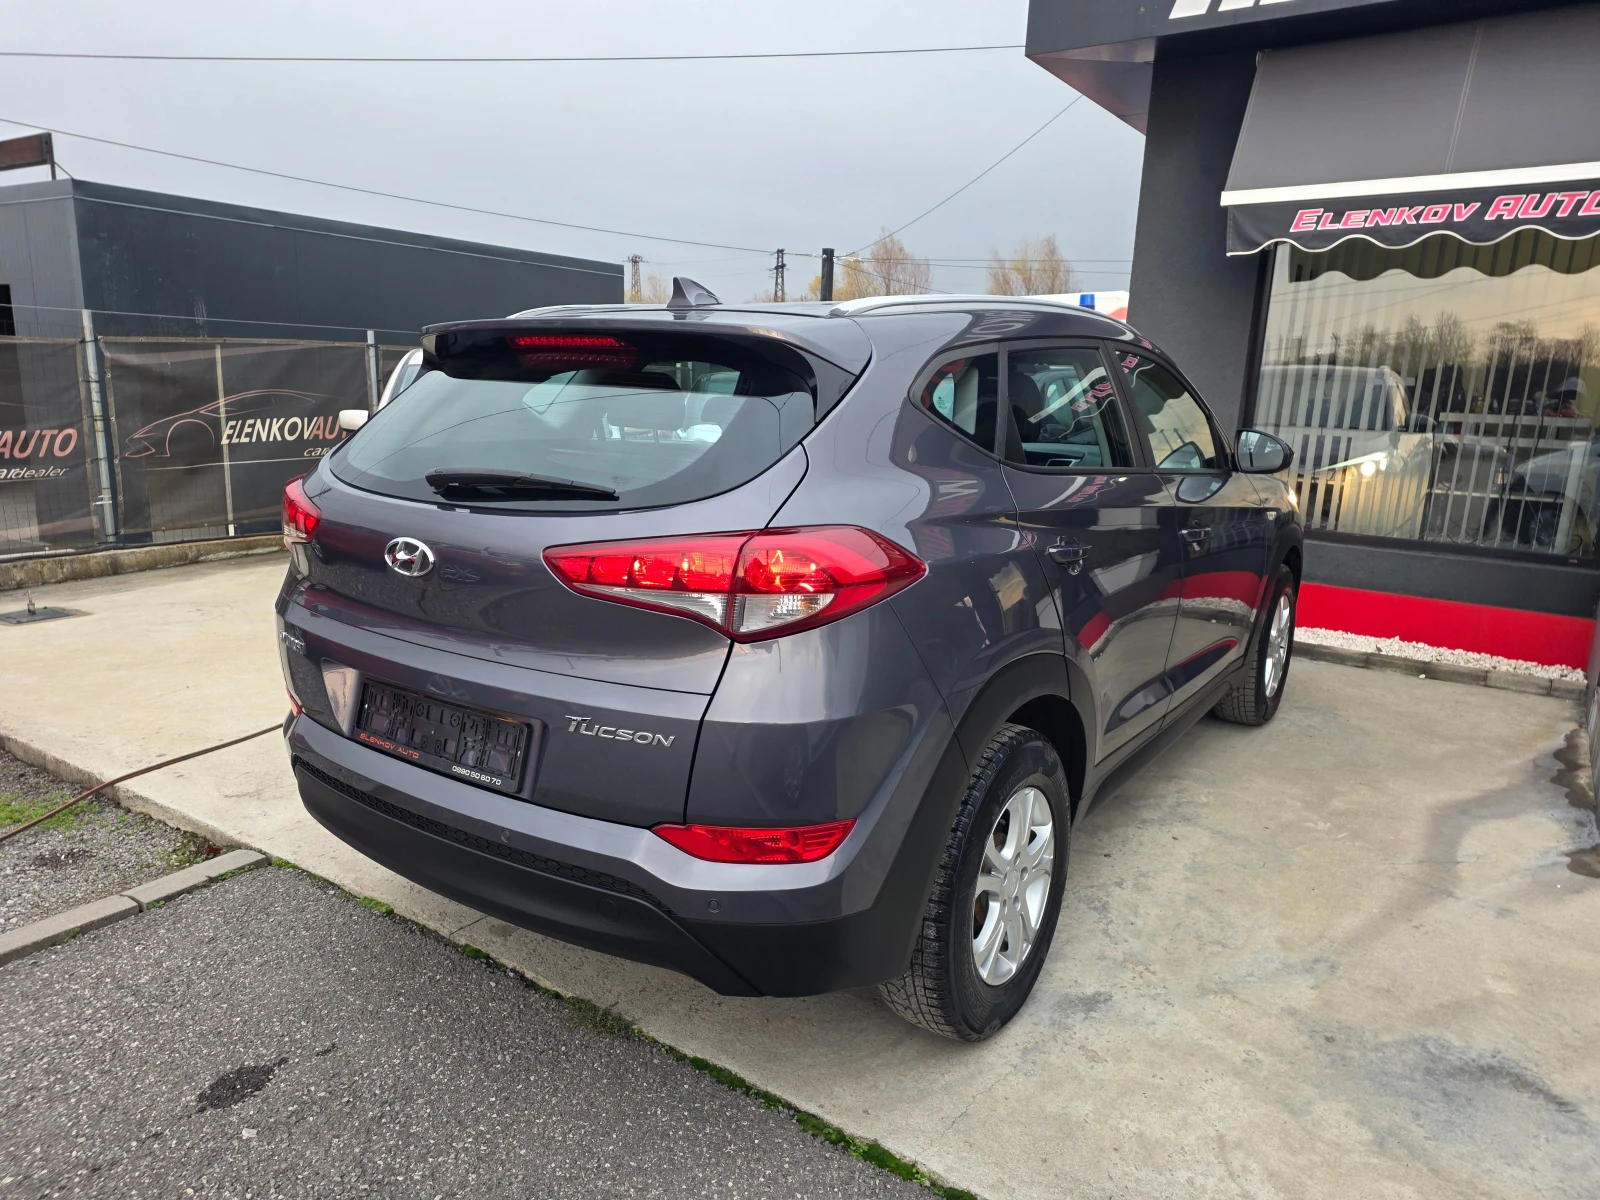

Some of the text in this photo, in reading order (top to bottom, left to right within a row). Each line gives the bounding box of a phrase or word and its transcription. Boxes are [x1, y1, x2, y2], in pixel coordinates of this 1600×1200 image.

[1289, 202, 1481, 233] ELENKOV
[0, 428, 78, 459] AUTO
[0, 465, 70, 479] ardealer
[564, 715, 676, 747] TUCSON
[397, 747, 420, 759] AUTO
[470, 771, 480, 779] 50
[480, 774, 490, 782] 60
